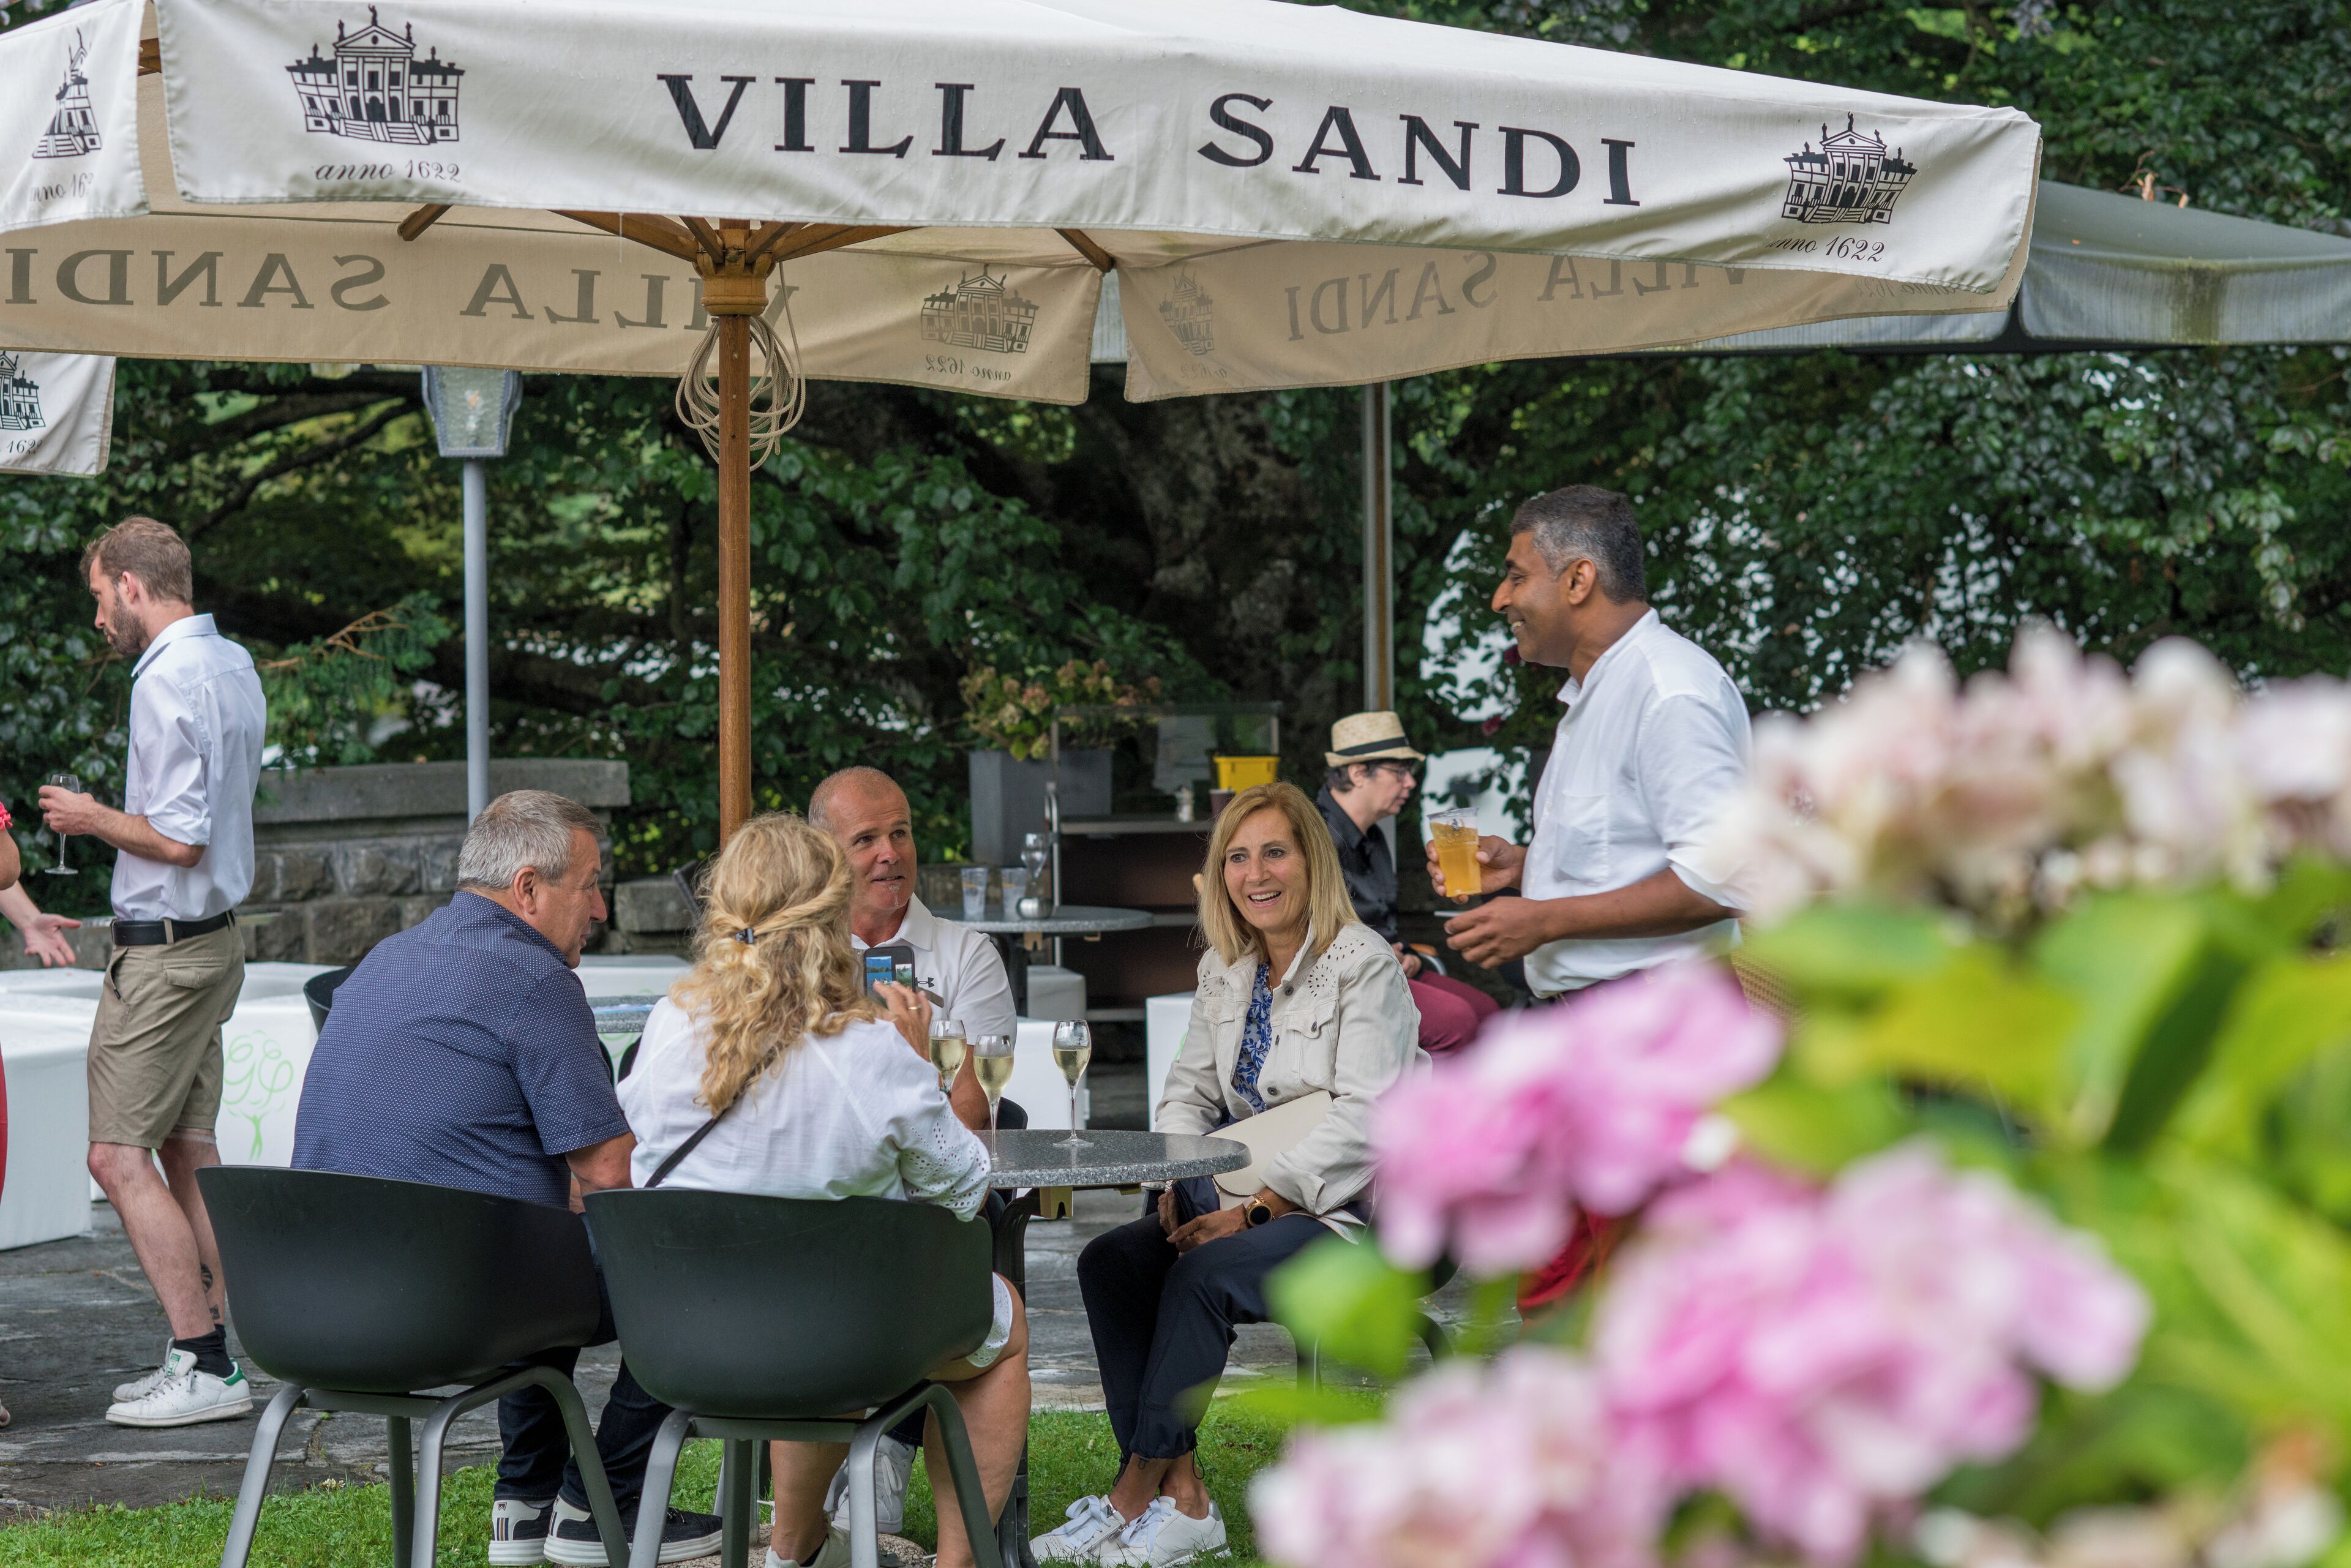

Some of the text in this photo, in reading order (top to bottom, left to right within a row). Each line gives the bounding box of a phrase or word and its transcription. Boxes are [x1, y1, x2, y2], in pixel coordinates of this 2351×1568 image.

[656, 73, 1641, 207] VILLA SANDI
[315, 159, 460, 182] anno 1622
[1826, 236, 1885, 262] 1622
